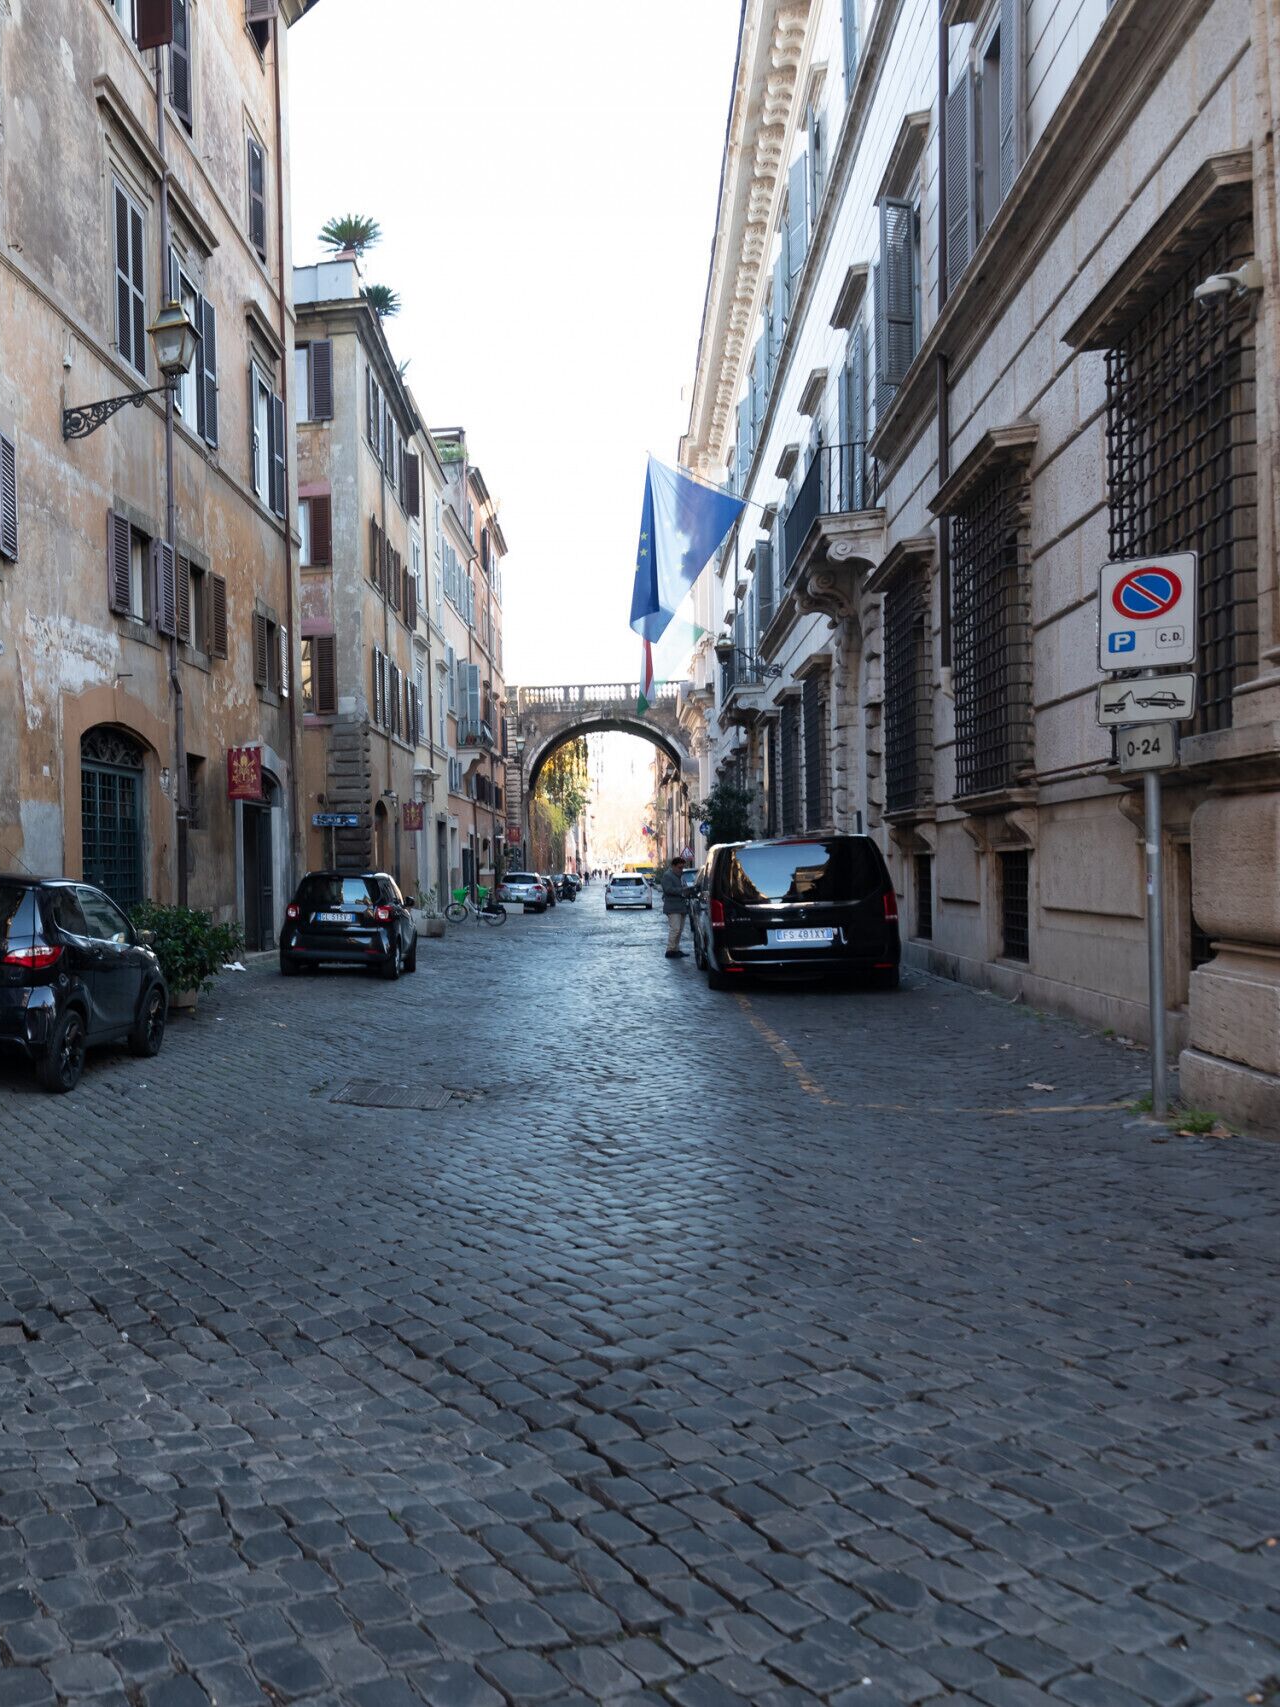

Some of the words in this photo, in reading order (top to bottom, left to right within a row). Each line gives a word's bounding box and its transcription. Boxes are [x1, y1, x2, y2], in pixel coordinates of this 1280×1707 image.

[1114, 633, 1131, 651] P
[1160, 632, 1182, 642] C.D.
[1127, 737, 1161, 757] 0-24
